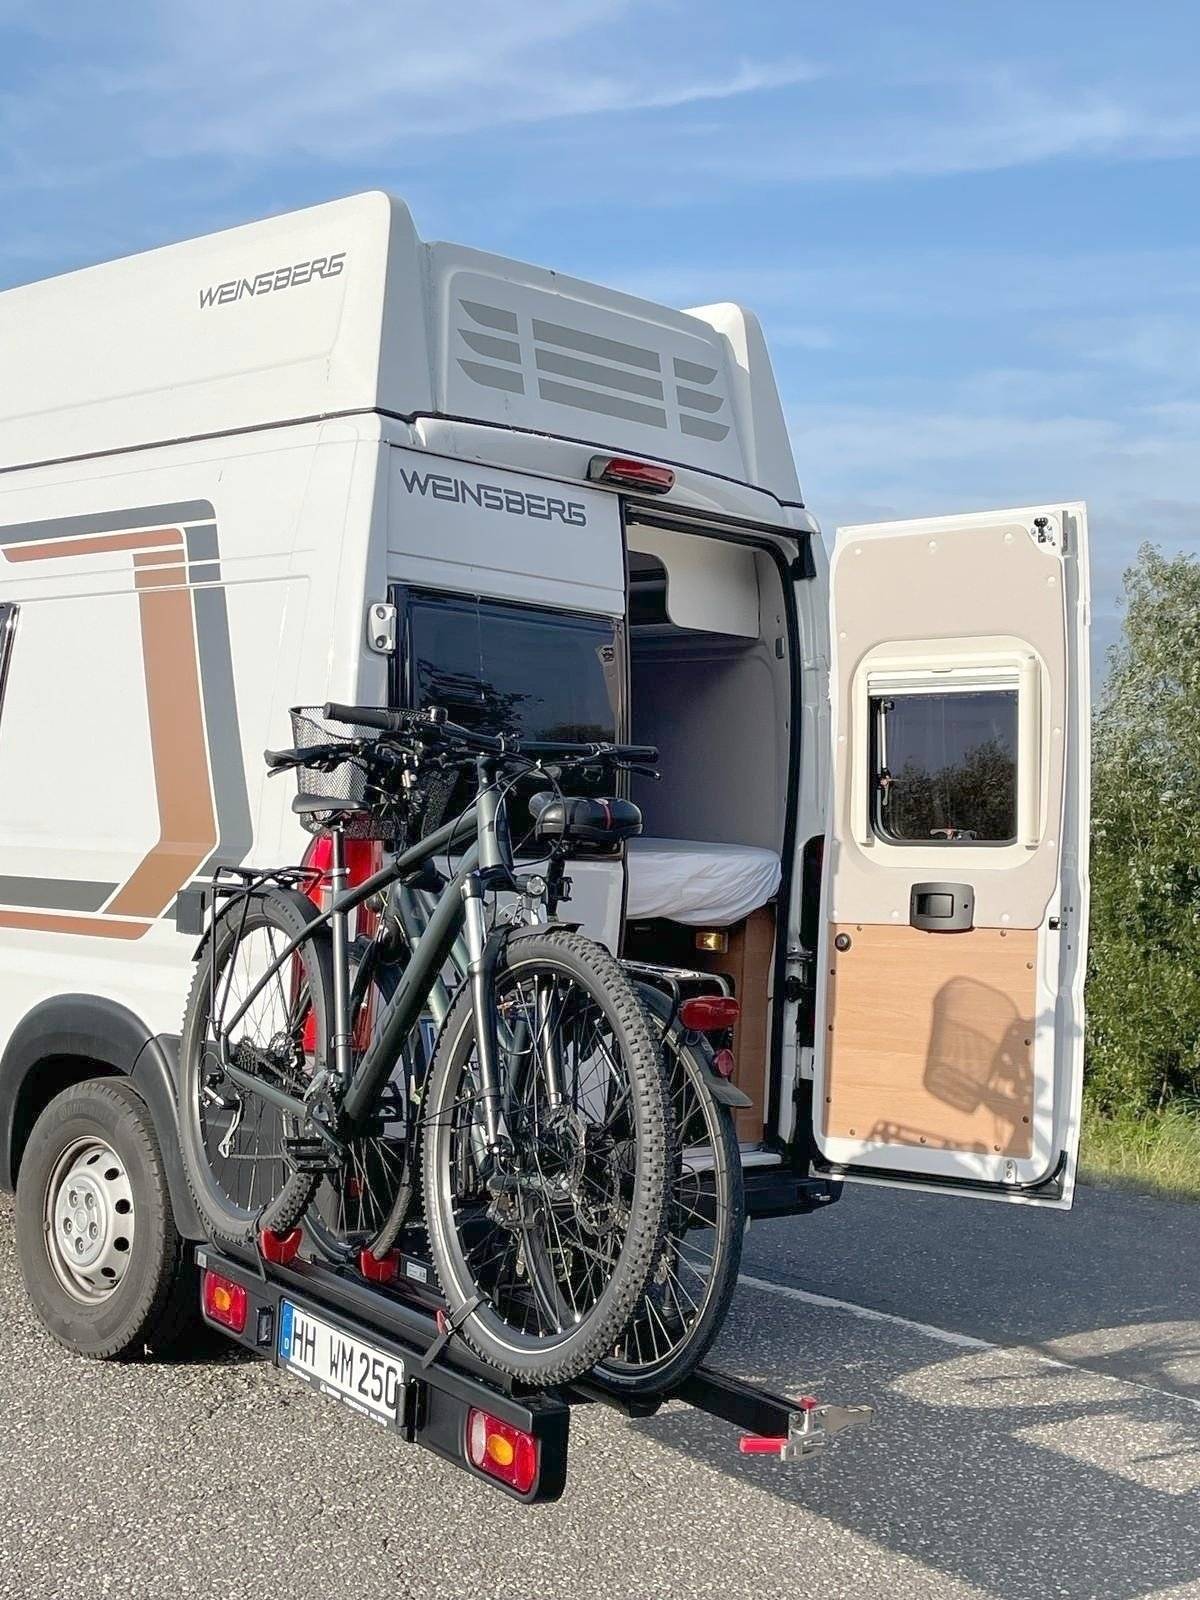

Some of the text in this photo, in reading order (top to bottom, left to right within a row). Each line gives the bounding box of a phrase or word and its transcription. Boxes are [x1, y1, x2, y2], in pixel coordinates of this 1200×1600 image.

[199, 251, 347, 309] WEINSBERG
[399, 467, 587, 527] WEINSBERG
[292, 1315, 398, 1411] HH WM 250
